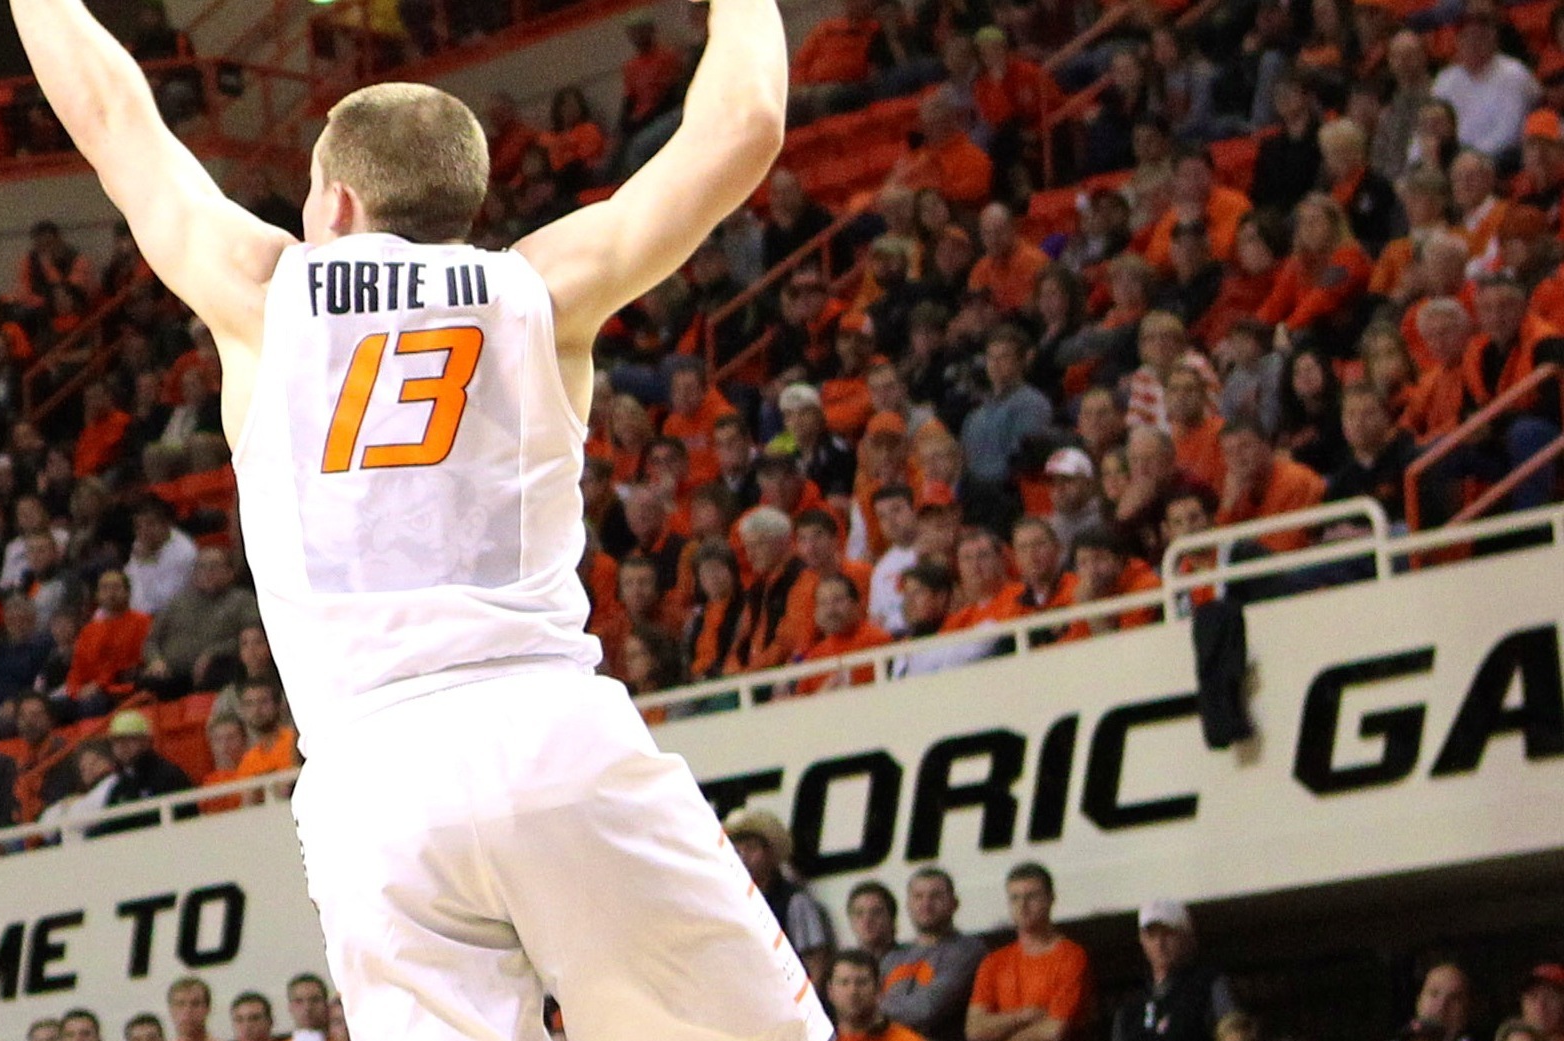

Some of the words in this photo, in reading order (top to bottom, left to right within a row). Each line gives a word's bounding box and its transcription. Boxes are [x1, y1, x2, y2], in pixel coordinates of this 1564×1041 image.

[307, 260, 427, 317] FORTE
[445, 264, 489, 307] III
[321, 325, 484, 474] 13
[115, 882, 246, 979] TO
